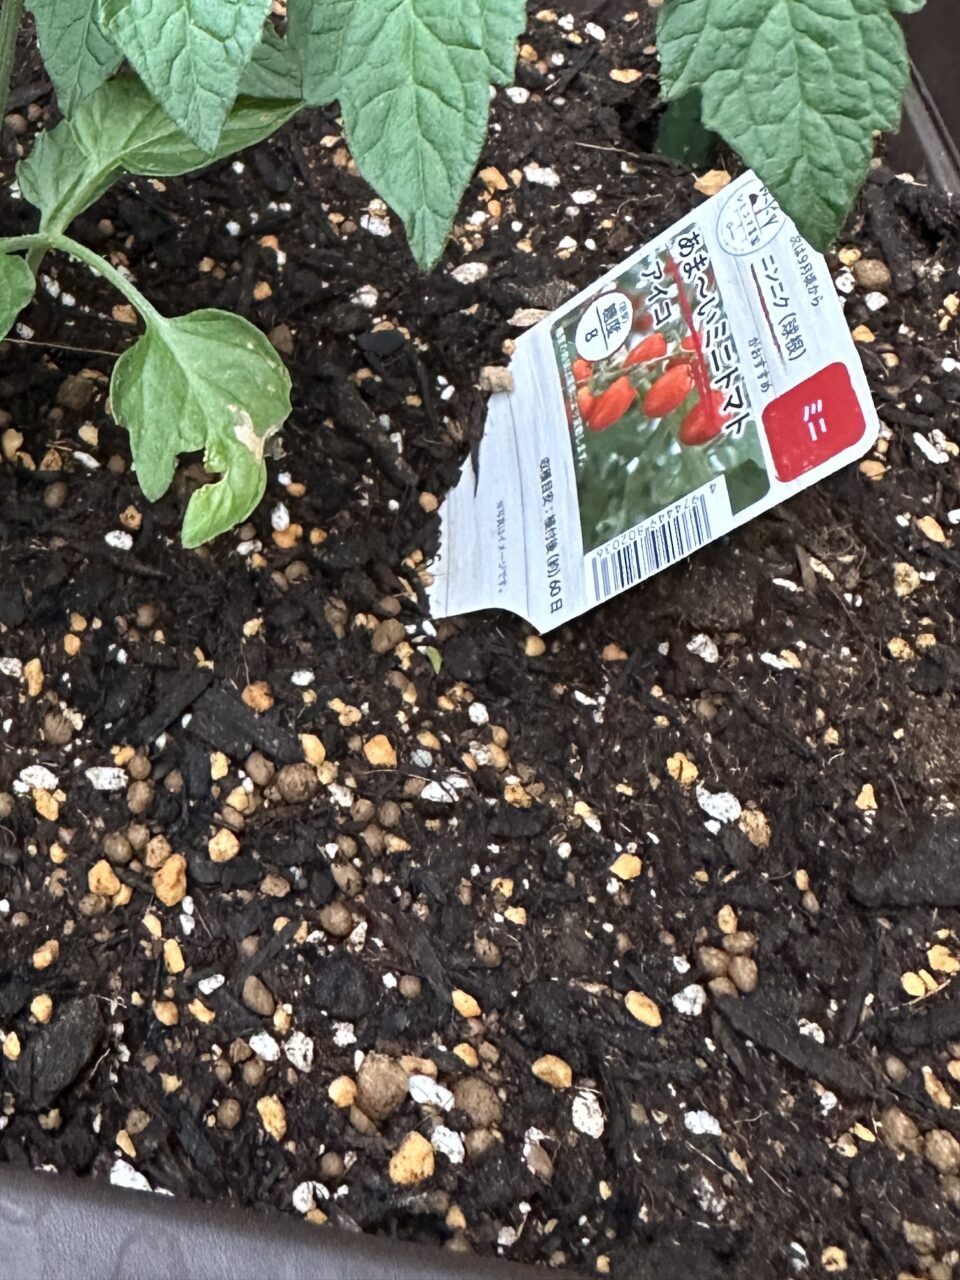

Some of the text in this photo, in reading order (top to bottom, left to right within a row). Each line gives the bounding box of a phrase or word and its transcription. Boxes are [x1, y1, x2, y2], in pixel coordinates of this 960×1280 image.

[641, 260, 672, 326] アイコ
[584, 327, 599, 343] 8
[748, 336, 773, 393] がおすすめ
[803, 399, 827, 441] ミニ
